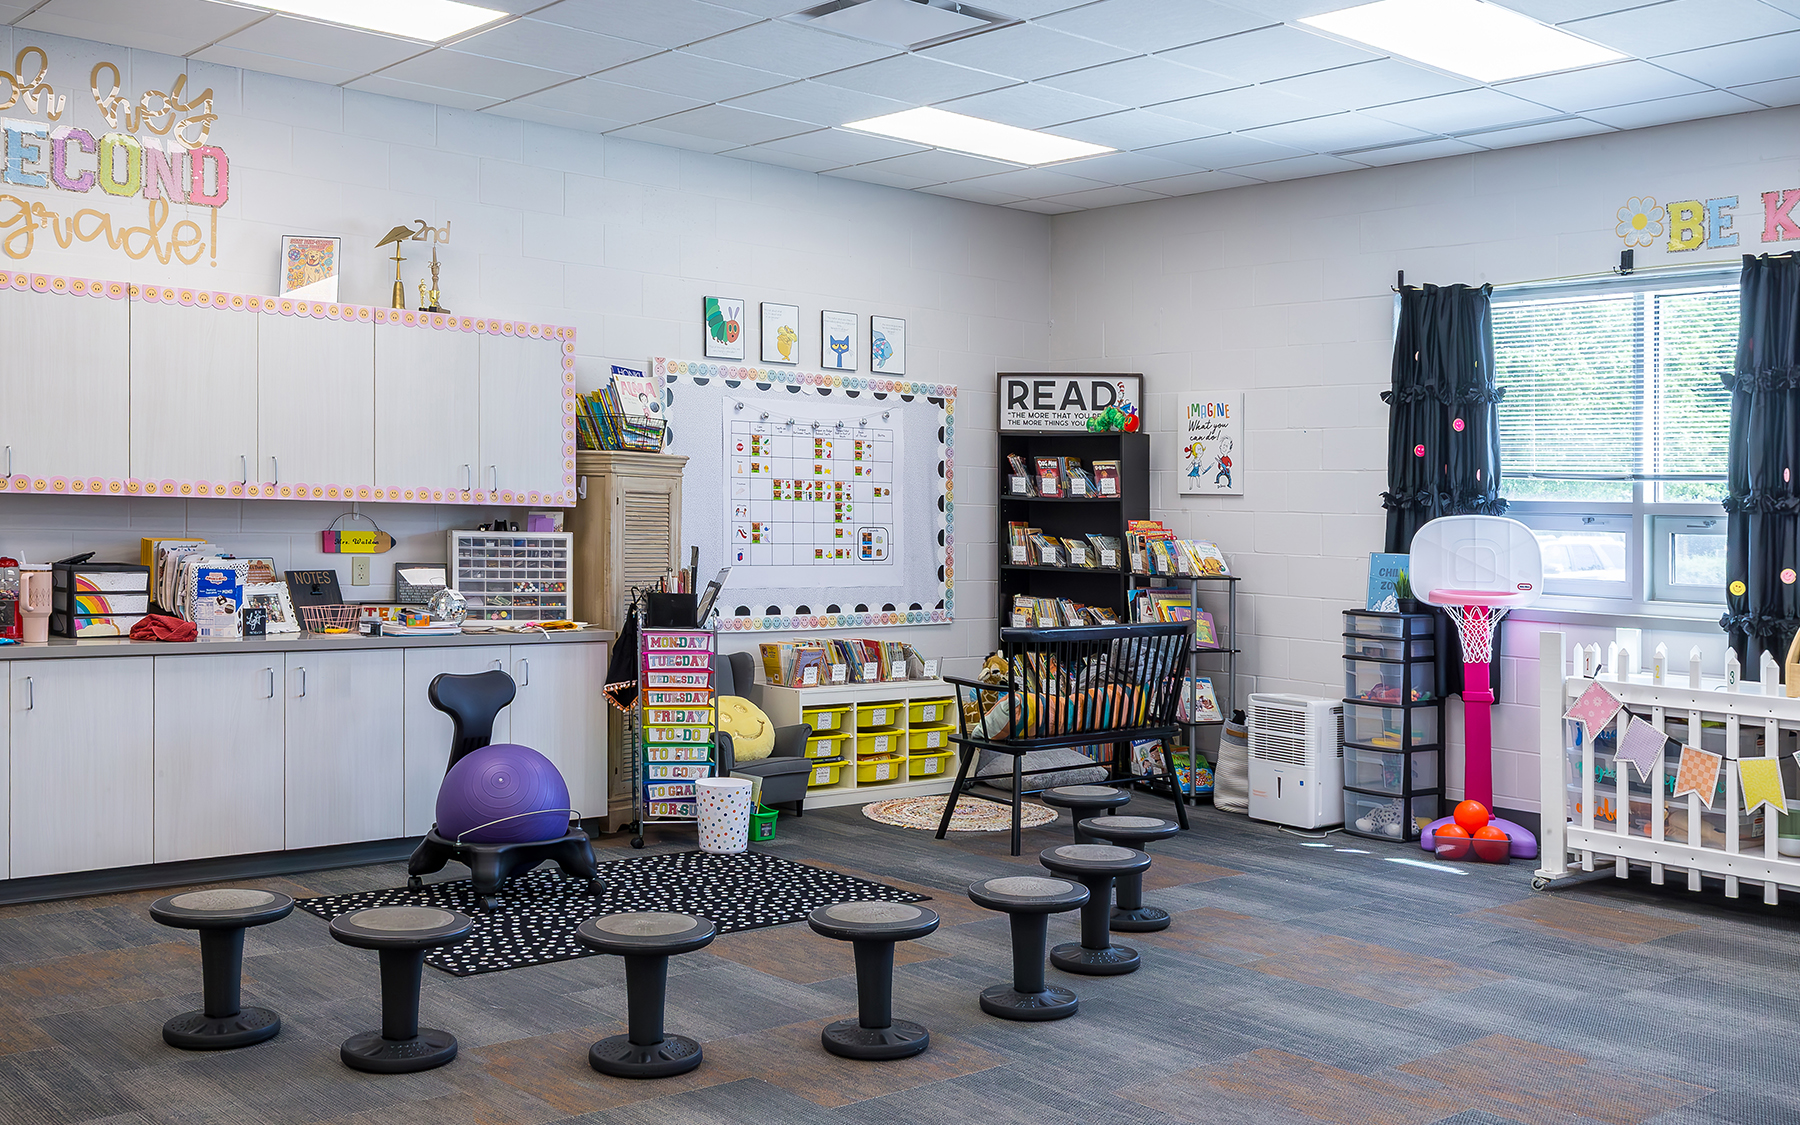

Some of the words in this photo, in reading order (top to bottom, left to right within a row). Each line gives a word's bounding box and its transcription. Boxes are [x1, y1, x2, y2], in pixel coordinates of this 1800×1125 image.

[91, 61, 218, 149] hey
[0, 194, 218, 268] grade!
[411, 219, 451, 244] 2nd
[1666, 196, 1740, 253] BE
[620, 380, 657, 398] ALMA
[1008, 380, 1117, 410] READ
[1187, 402, 1230, 419] IMAGINE
[1188, 419, 1212, 432] What
[1212, 422, 1229, 435] you
[1206, 430, 1222, 441] do!
[293, 571, 332, 585] NOTES
[1378, 567, 1399, 578] CHIL
[1380, 581, 1394, 590] ZO
[650, 637, 705, 648] MONDAY
[649, 655, 708, 667] TUESDAY
[1585, 657, 1590, 671] 1
[1655, 664, 1660, 679] 2
[1729, 670, 1735, 685] 3
[649, 692, 708, 703] THURSDAY
[654, 710, 705, 722] FRIDAY
[656, 728, 675, 740] TO
[682, 728, 701, 741] DO
[649, 748, 669, 760] TO
[674, 748, 706, 760] FILE
[651, 766, 668, 777] TO
[672, 767, 706, 778] COPY
[649, 786, 665, 797] TO
[668, 785, 697, 796] GRA
[650, 802, 677, 815] FOR
[679, 804, 698, 816] SU
